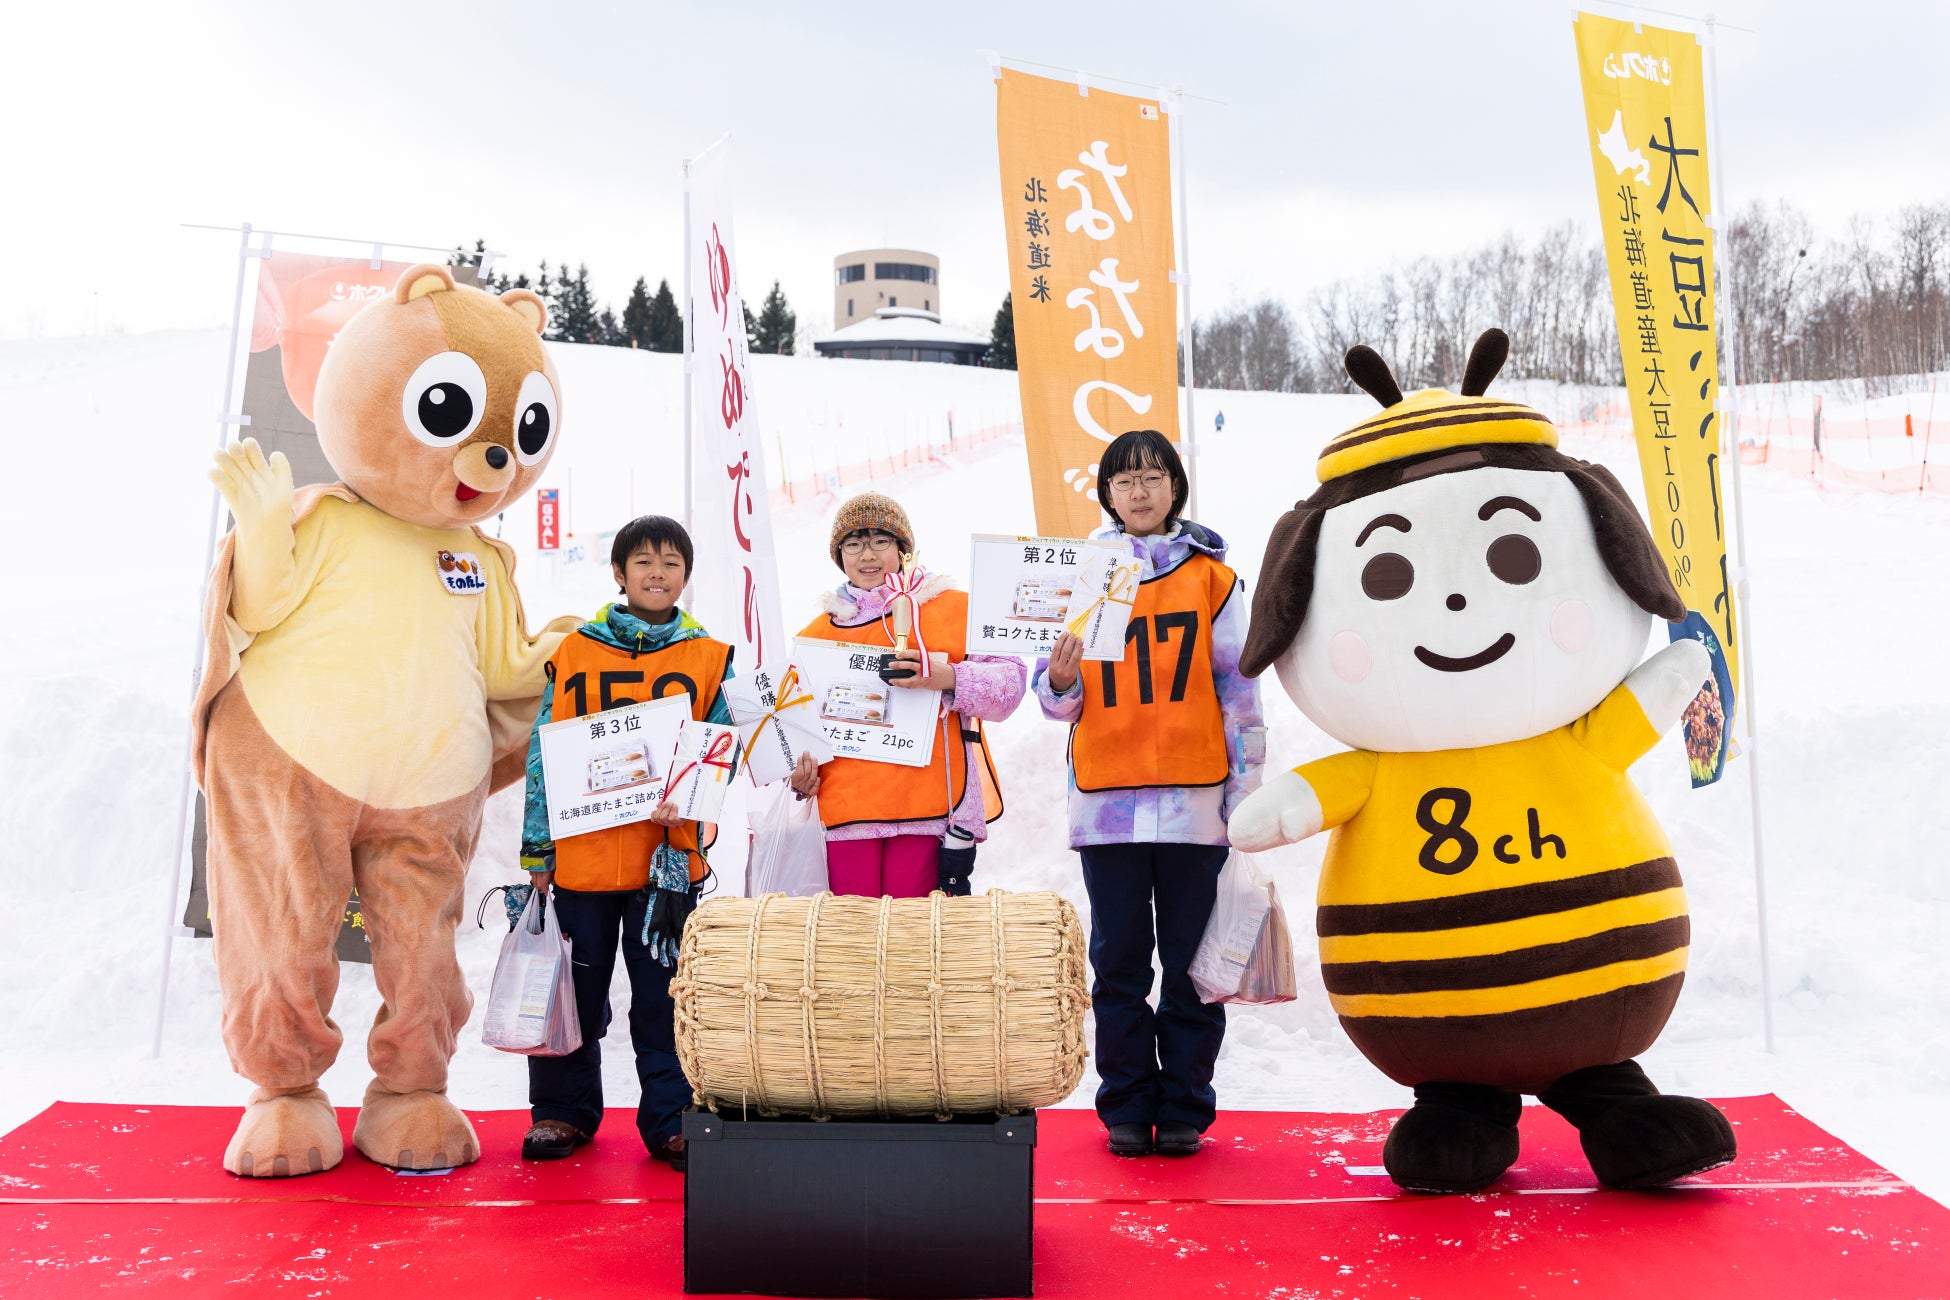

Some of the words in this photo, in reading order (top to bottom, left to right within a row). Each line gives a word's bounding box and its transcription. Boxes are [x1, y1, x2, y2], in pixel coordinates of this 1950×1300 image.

[541, 503, 554, 549] GOAL
[1023, 545, 1077, 566] 第2位
[848, 653, 881, 673] 優勝
[755, 672, 777, 708] 優勝
[589, 713, 642, 740] 第3位
[823, 725, 871, 743] たまご
[882, 733, 914, 750] 21pc
[1415, 786, 1567, 876] 8ch
